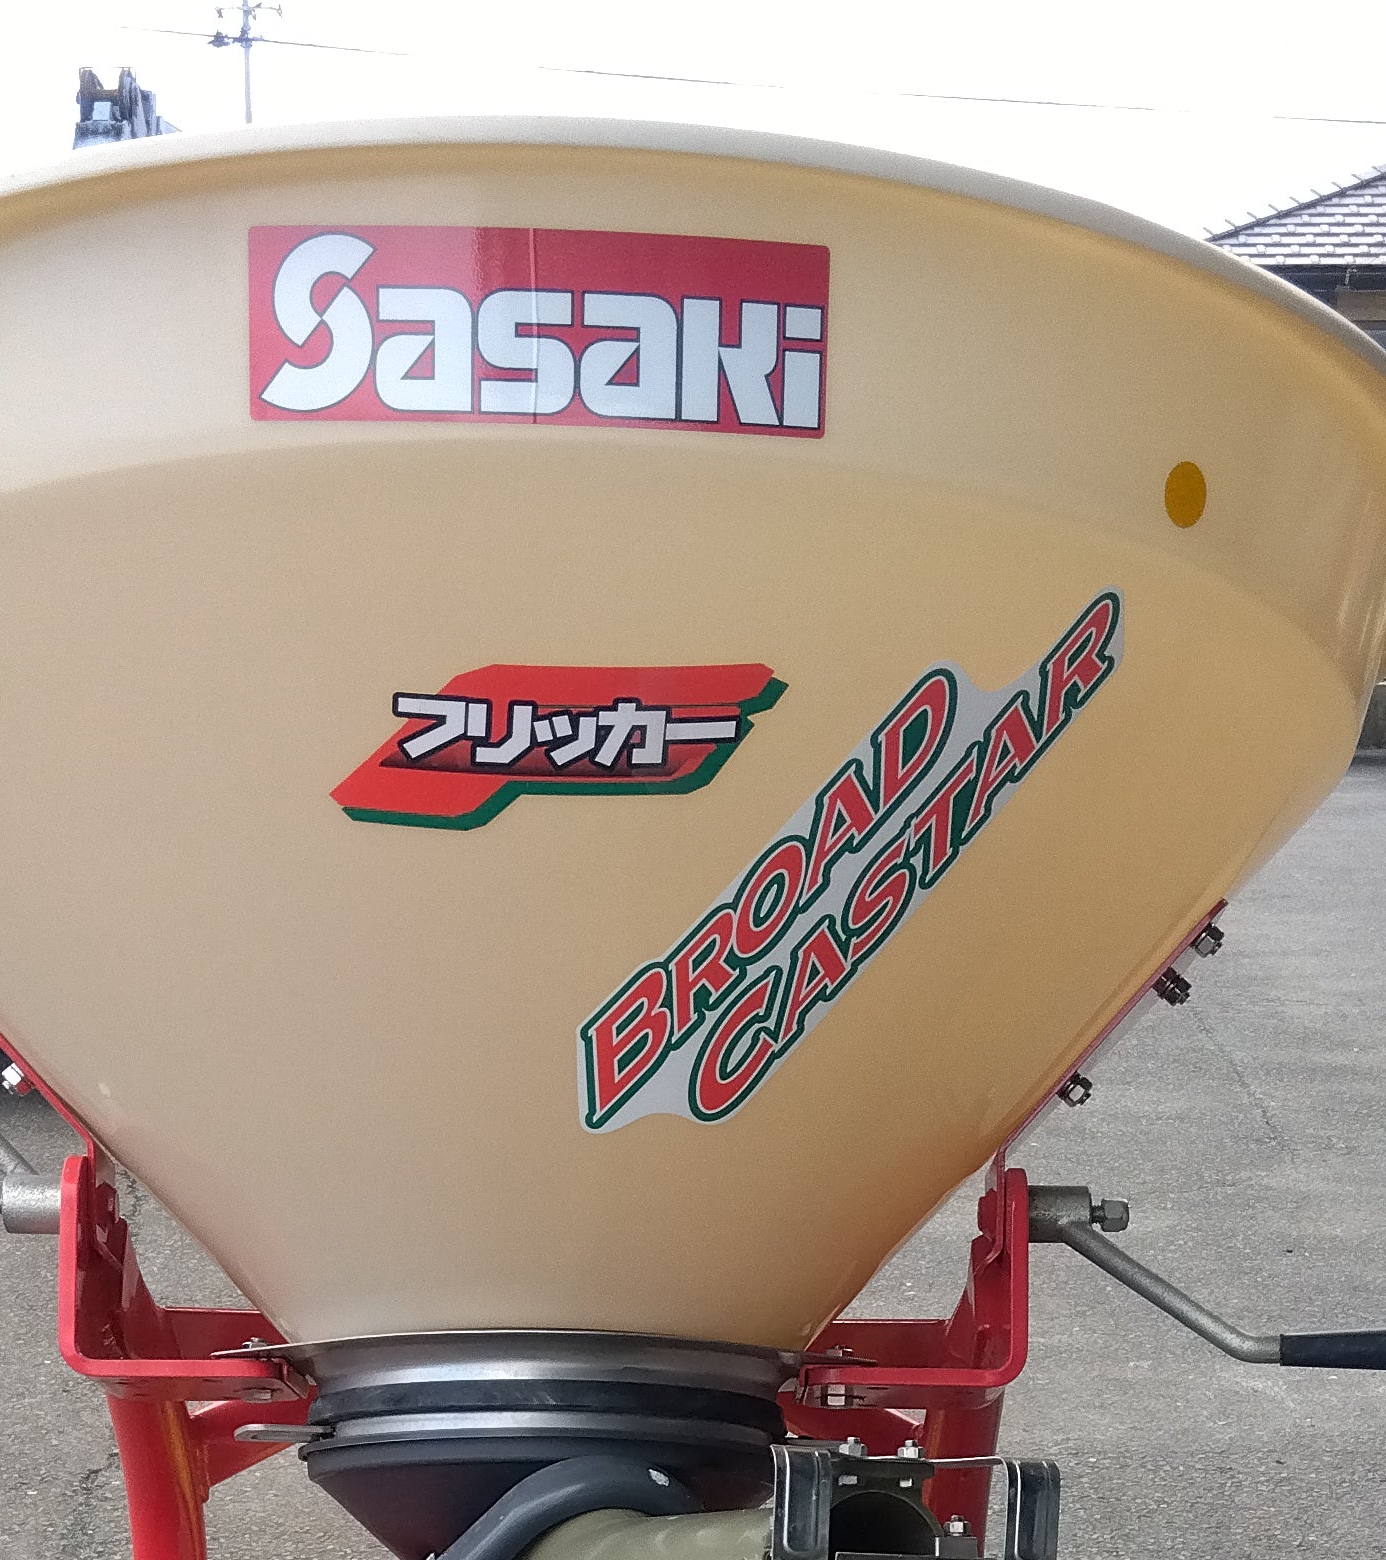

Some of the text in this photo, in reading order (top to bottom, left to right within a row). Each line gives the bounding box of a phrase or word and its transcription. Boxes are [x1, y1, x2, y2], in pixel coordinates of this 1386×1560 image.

[258, 231, 826, 430] Sasaki
[393, 692, 741, 770] フリッカー
[688, 590, 1121, 1124] CASTAR
[582, 667, 959, 1129] BROAD
